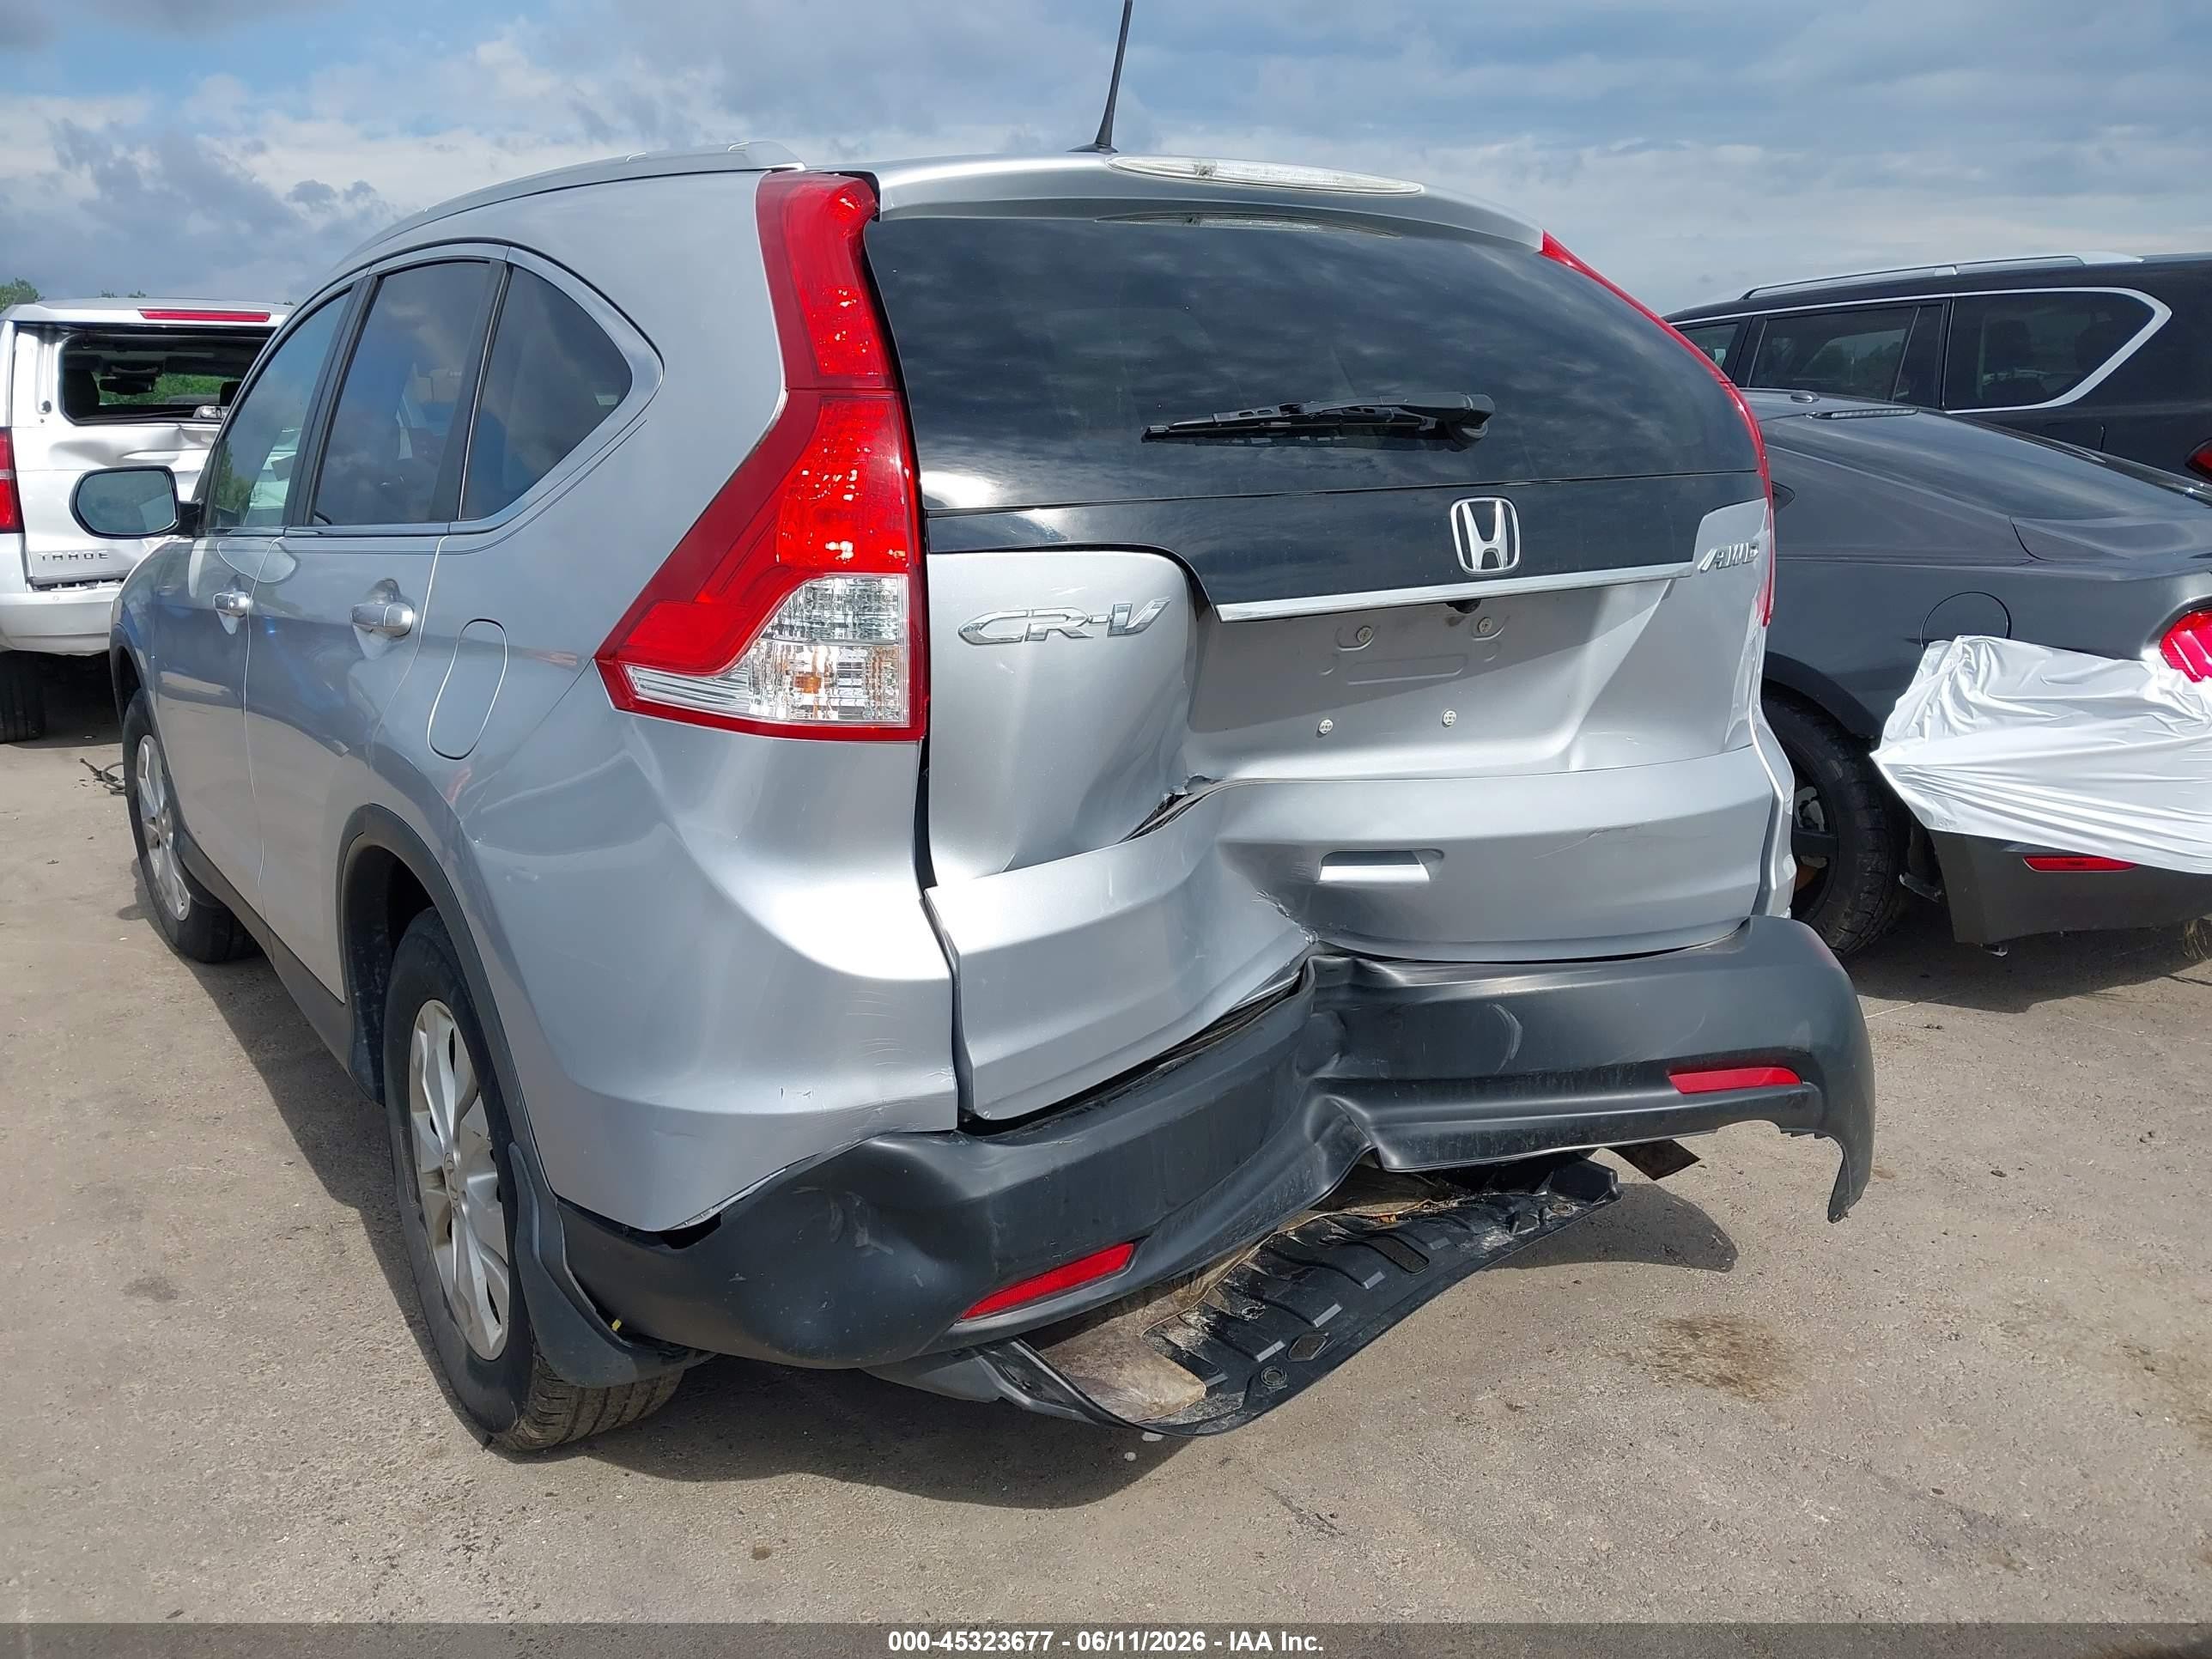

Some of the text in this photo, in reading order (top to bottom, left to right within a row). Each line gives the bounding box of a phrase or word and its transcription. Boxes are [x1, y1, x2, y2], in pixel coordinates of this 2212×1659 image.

[38, 550, 111, 562] TAHOE
[1697, 542, 1759, 573] AWD
[957, 597, 1171, 645] CR-V
